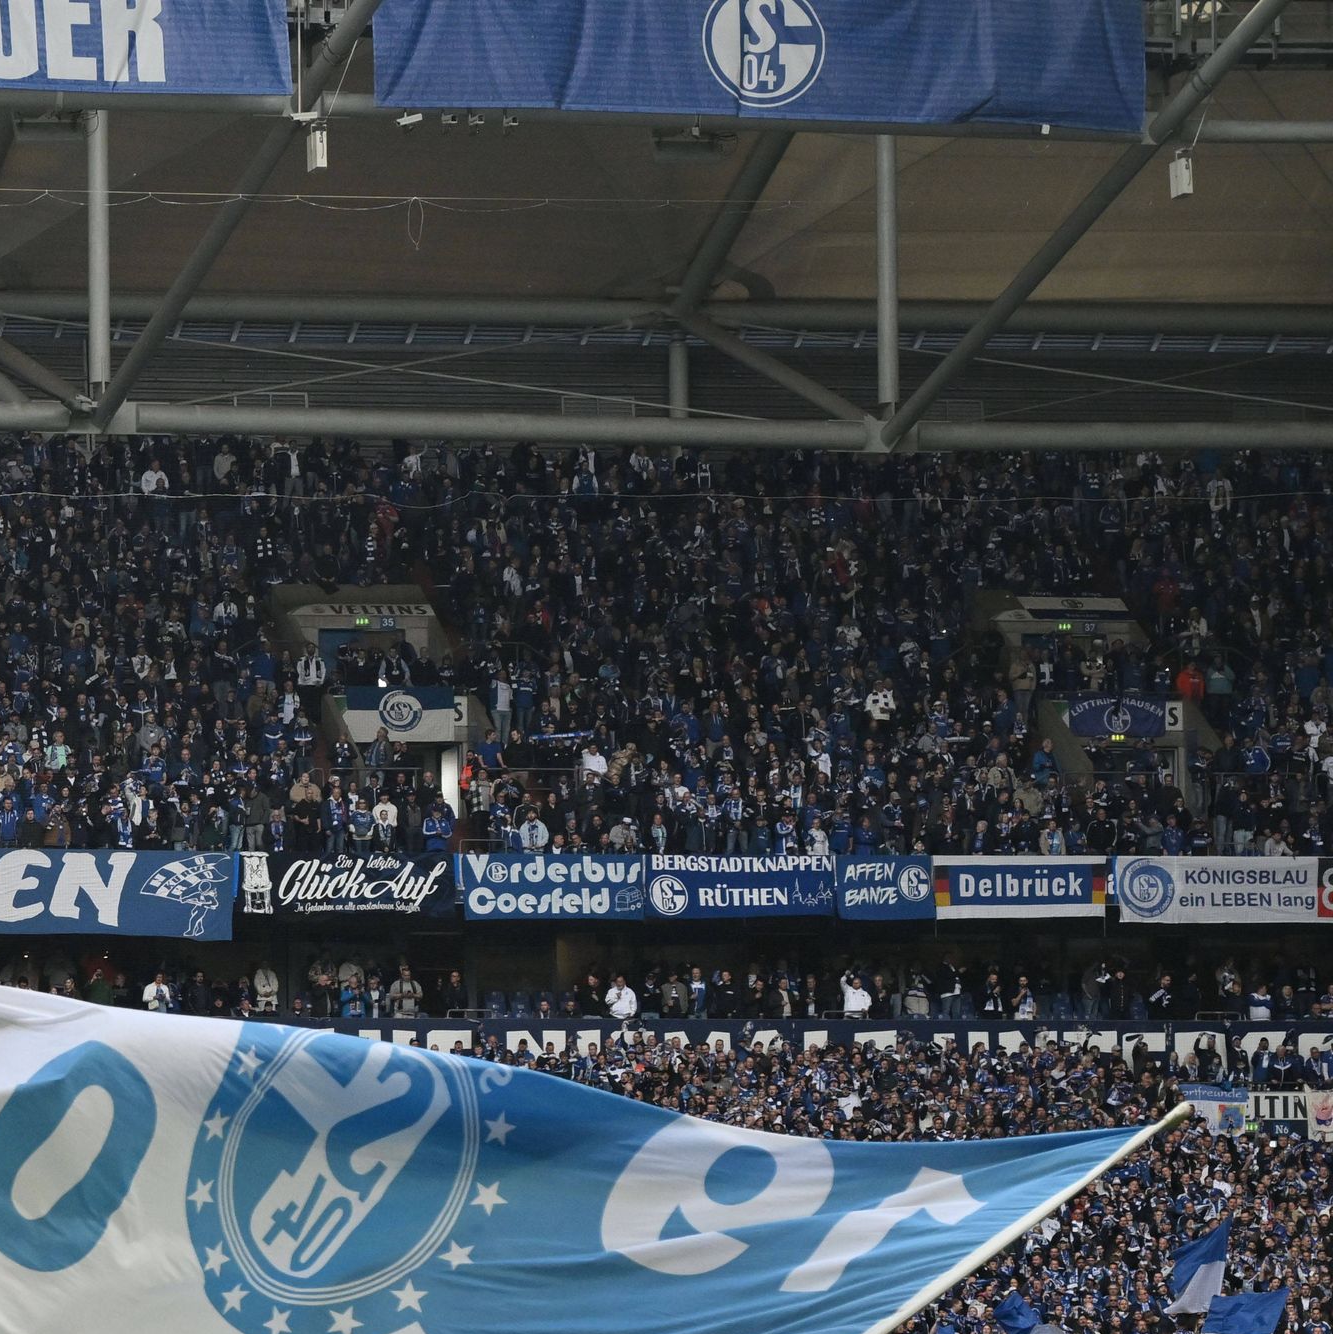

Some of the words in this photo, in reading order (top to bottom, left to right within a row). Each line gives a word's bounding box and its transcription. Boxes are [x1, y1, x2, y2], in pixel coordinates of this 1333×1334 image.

[329, 604, 428, 616] VELTINS
[334, 853, 354, 869] Ein
[651, 854, 833, 874] BERGSTADTKNAPPEN
[278, 857, 370, 906] Glück
[844, 862, 896, 883] AFFEN
[1184, 867, 1309, 885] KÖNIGSBLAU
[959, 869, 1084, 898] Delbrück
[468, 887, 610, 914] Coesfeld
[698, 883, 789, 907] RÜTHEN
[844, 886, 899, 908] BANDE
[1179, 892, 1205, 907] ein
[1211, 892, 1272, 907] LEBEN
[1277, 892, 1316, 910] lang
[1275, 1124, 1289, 1135] N6
